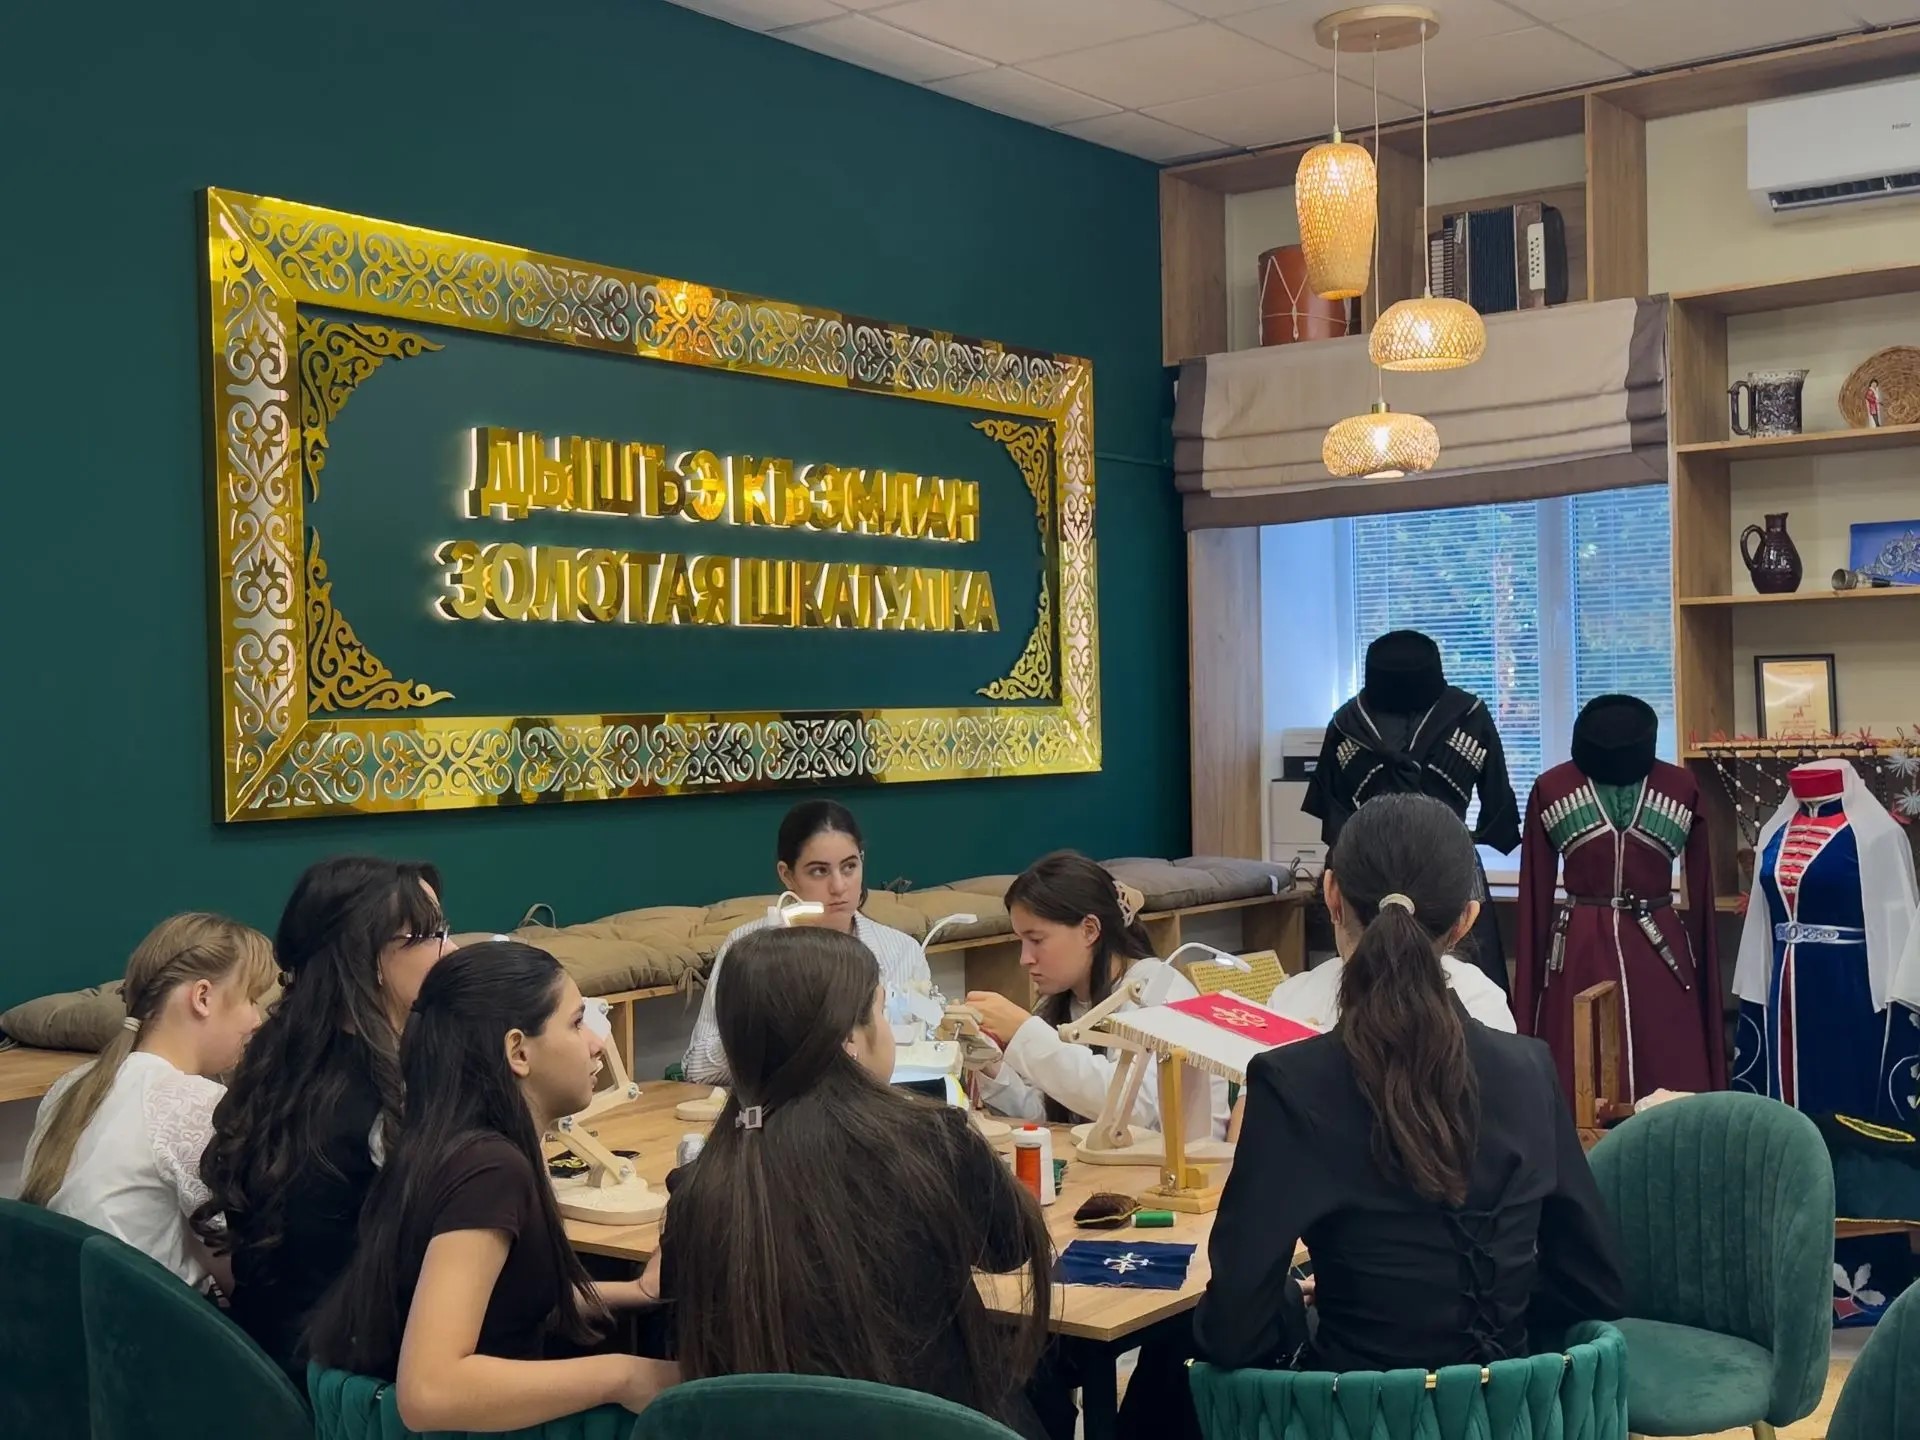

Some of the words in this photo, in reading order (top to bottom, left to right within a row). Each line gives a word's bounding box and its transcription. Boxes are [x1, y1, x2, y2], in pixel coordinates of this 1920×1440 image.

[464, 427, 728, 521] ДЫШЪЭ
[433, 539, 733, 626] ЗОЛОТАЯ
[733, 556, 1001, 632] ШКАТУЛКА
